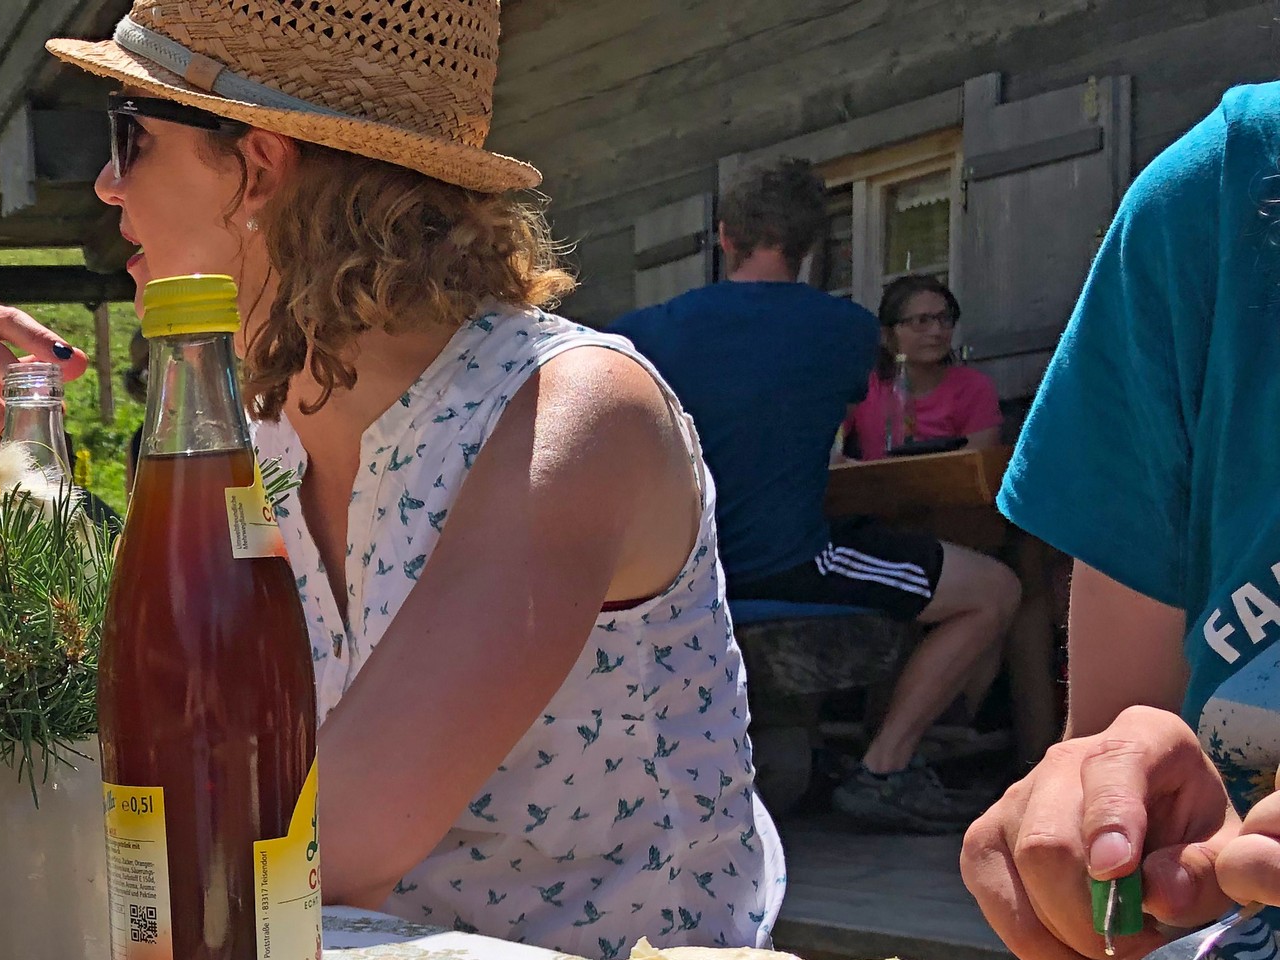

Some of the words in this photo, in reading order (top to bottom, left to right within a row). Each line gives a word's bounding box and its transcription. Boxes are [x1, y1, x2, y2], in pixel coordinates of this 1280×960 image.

[260, 850, 268, 886] Teisendorf
[261, 889, 269, 910] 83317
[262, 923, 270, 959] Poststraße
